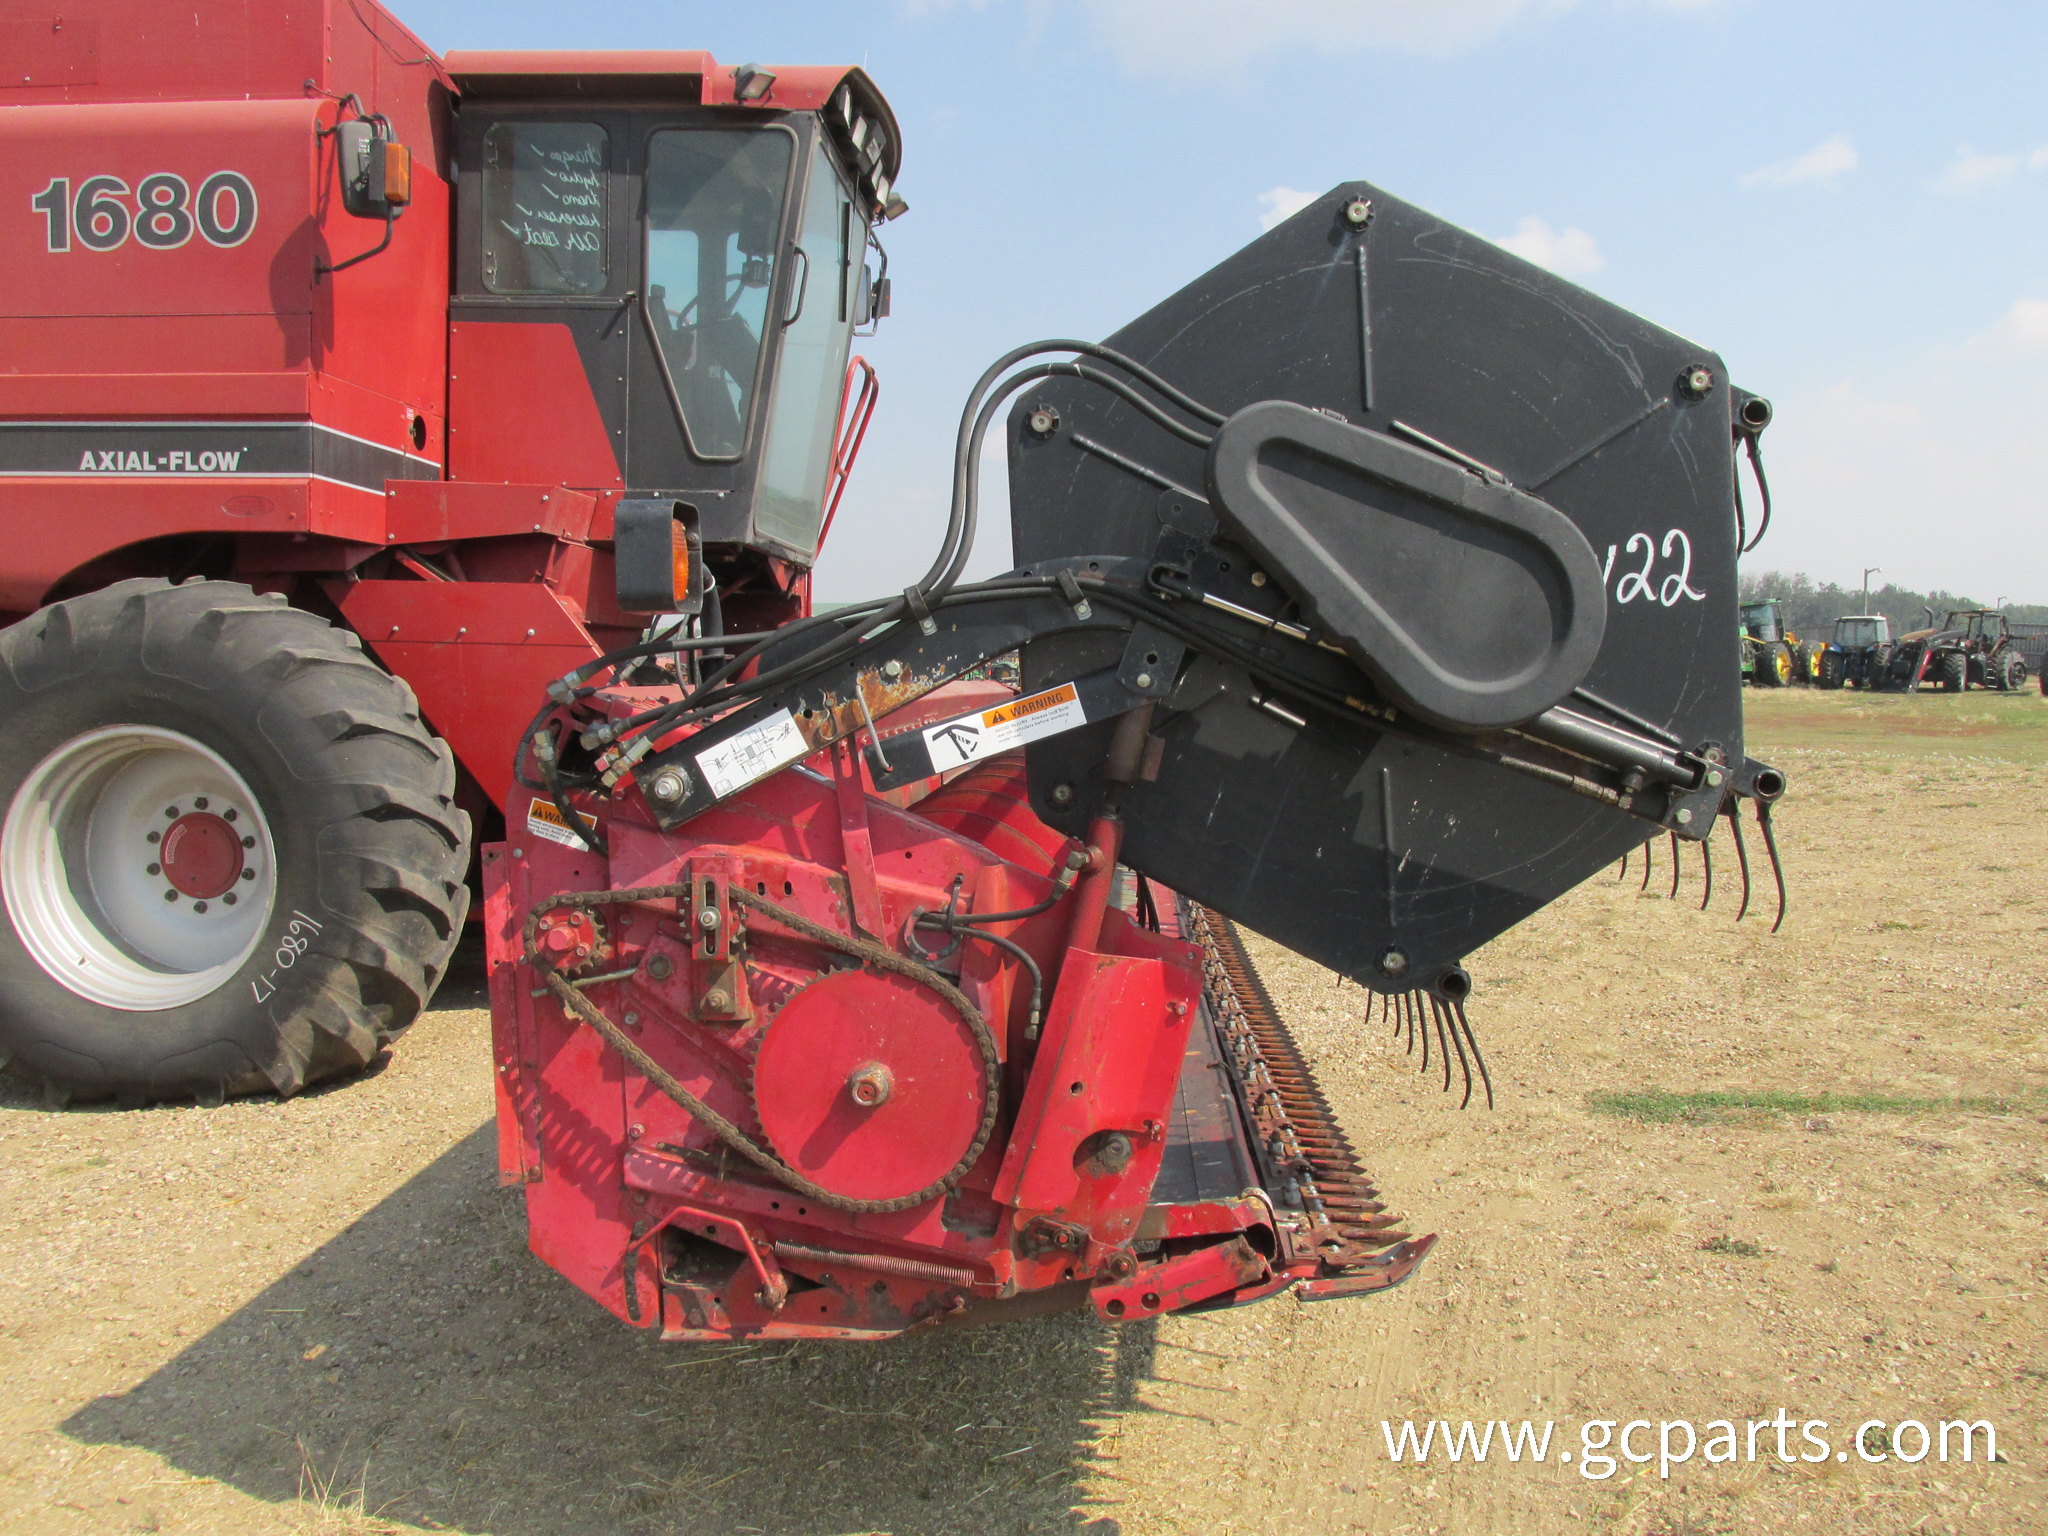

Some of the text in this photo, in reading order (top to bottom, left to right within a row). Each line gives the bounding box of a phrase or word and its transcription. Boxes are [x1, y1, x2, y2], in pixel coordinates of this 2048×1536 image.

[32, 170, 258, 253] 1680
[79, 451, 241, 472] AXIAL-FLOW
[1010, 692, 1063, 717] WARNING
[251, 909, 323, 1004] 1680-17
